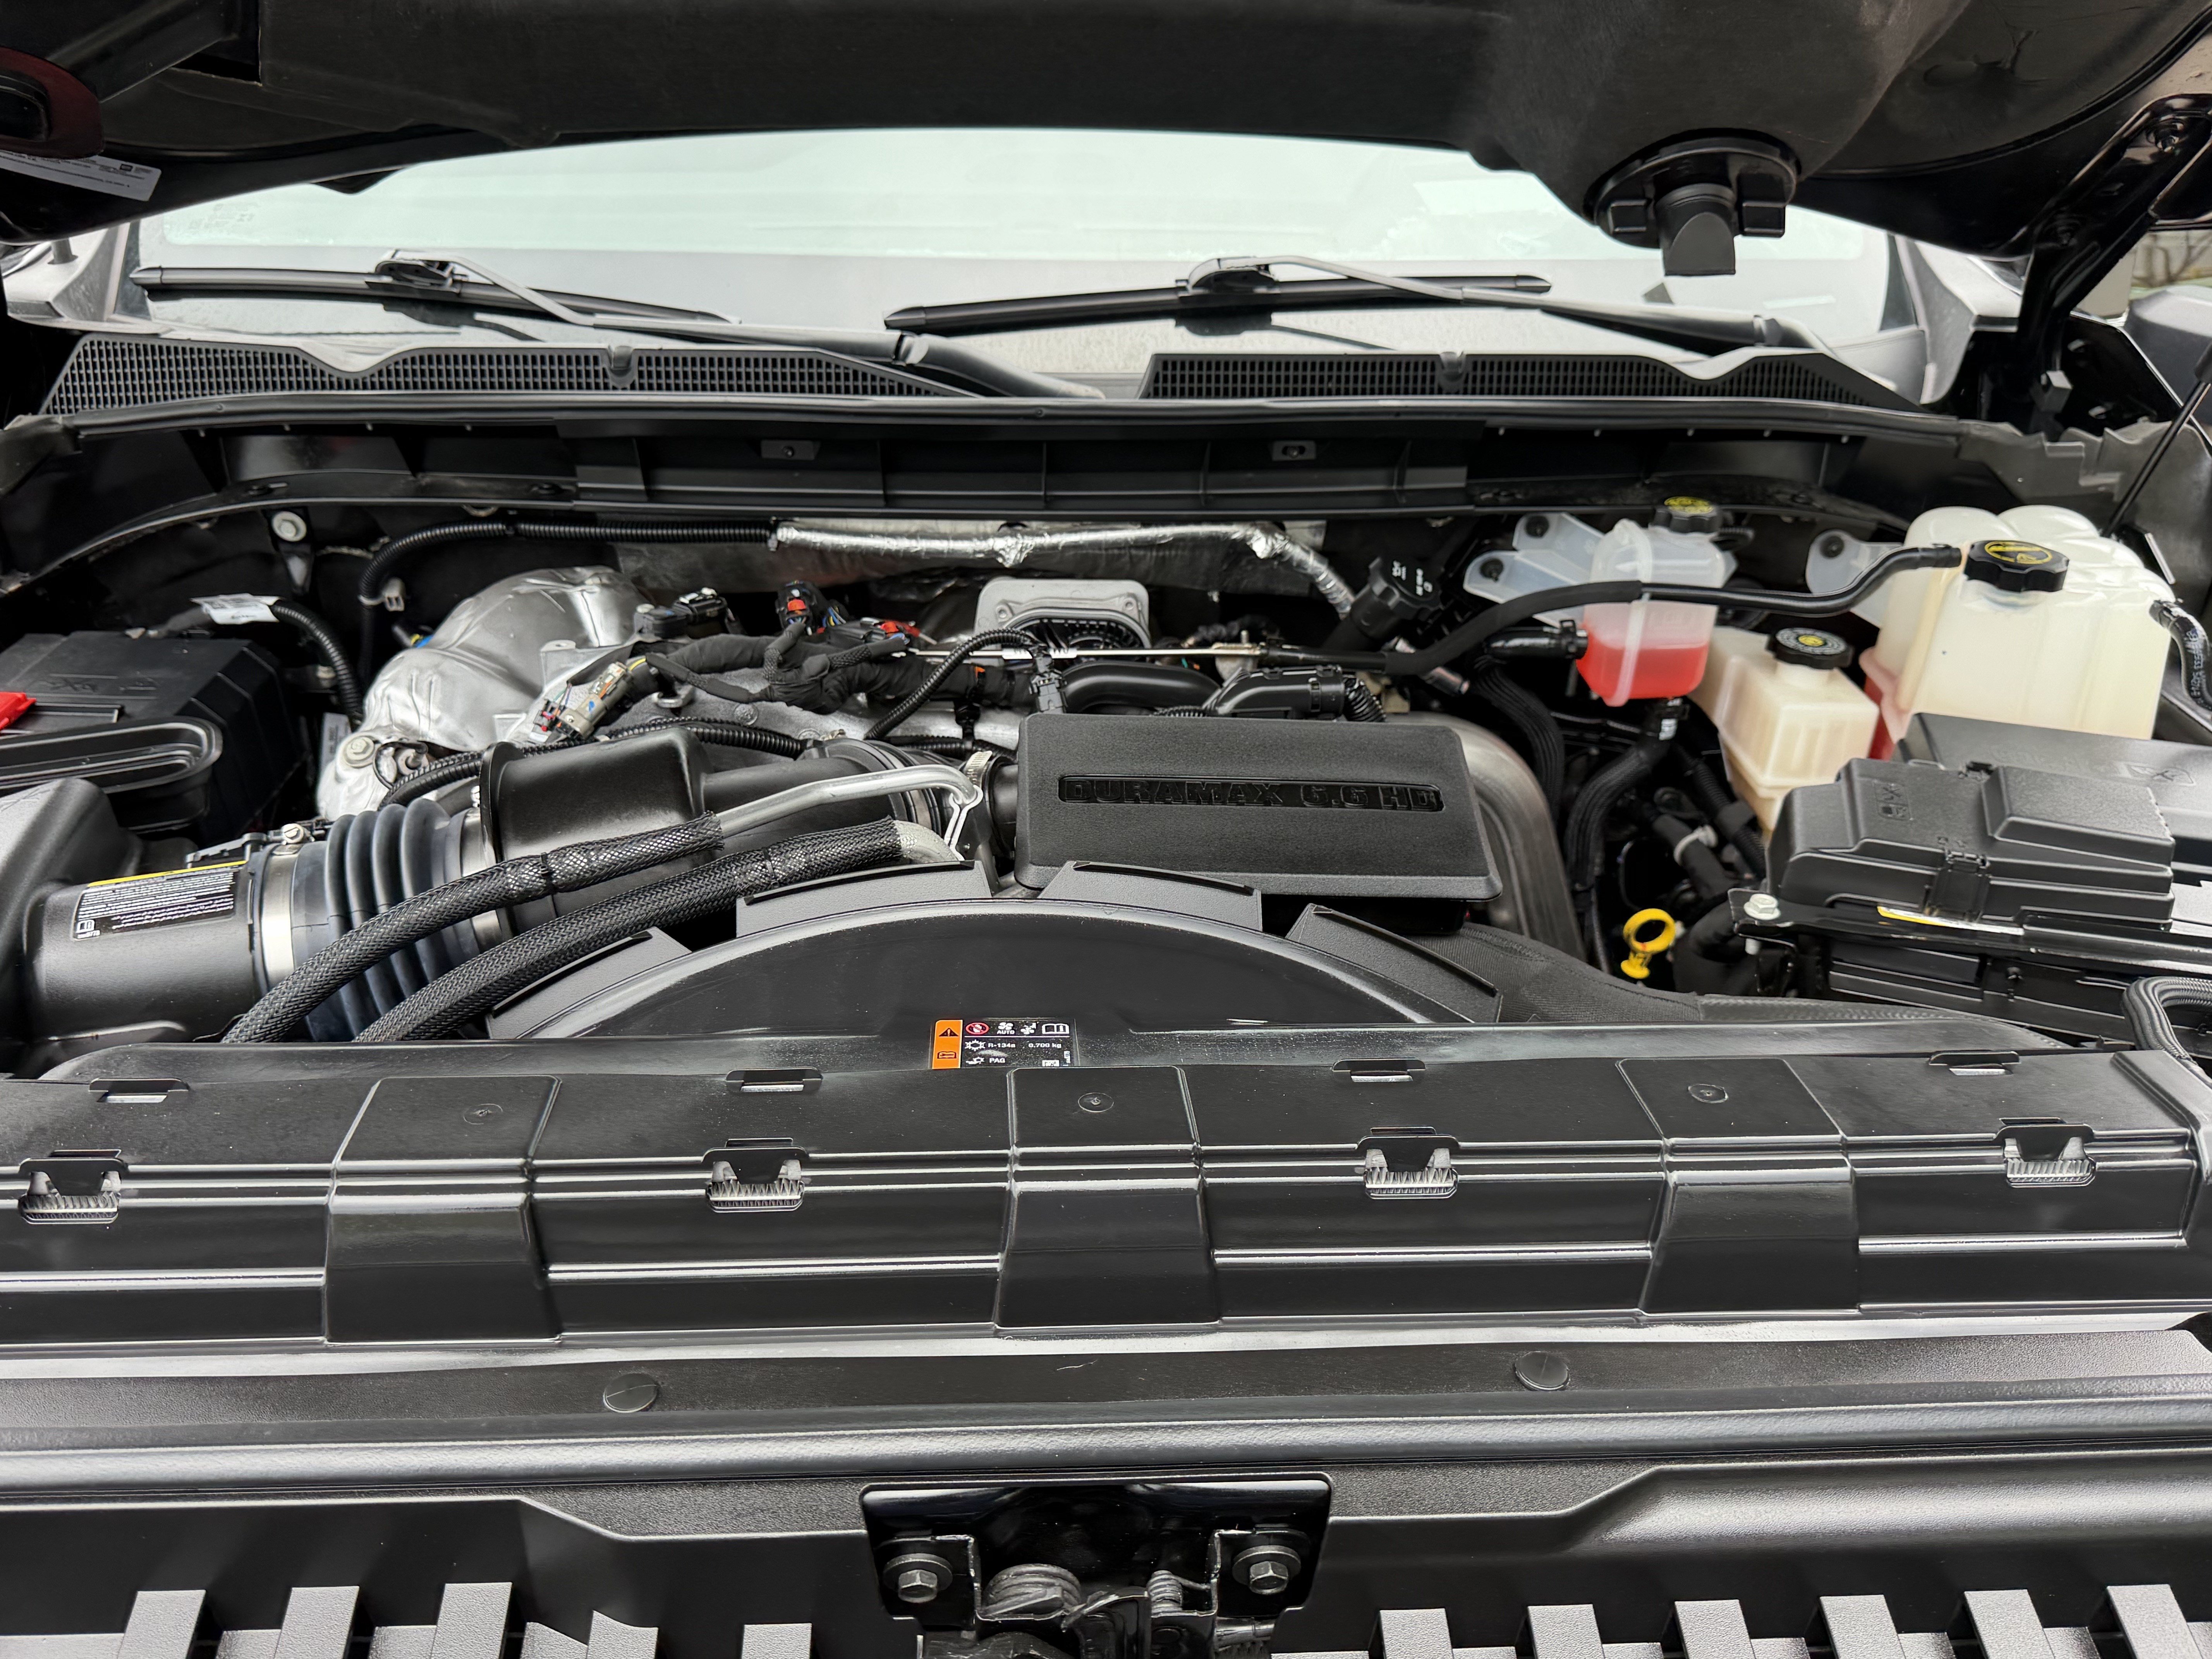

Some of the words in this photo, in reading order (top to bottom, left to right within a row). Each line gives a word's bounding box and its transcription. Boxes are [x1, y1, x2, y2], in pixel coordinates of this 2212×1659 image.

[1065, 780, 1283, 806] DURAMAX
[1301, 785, 1368, 807] 6.6
[1378, 786, 1437, 811] HD
